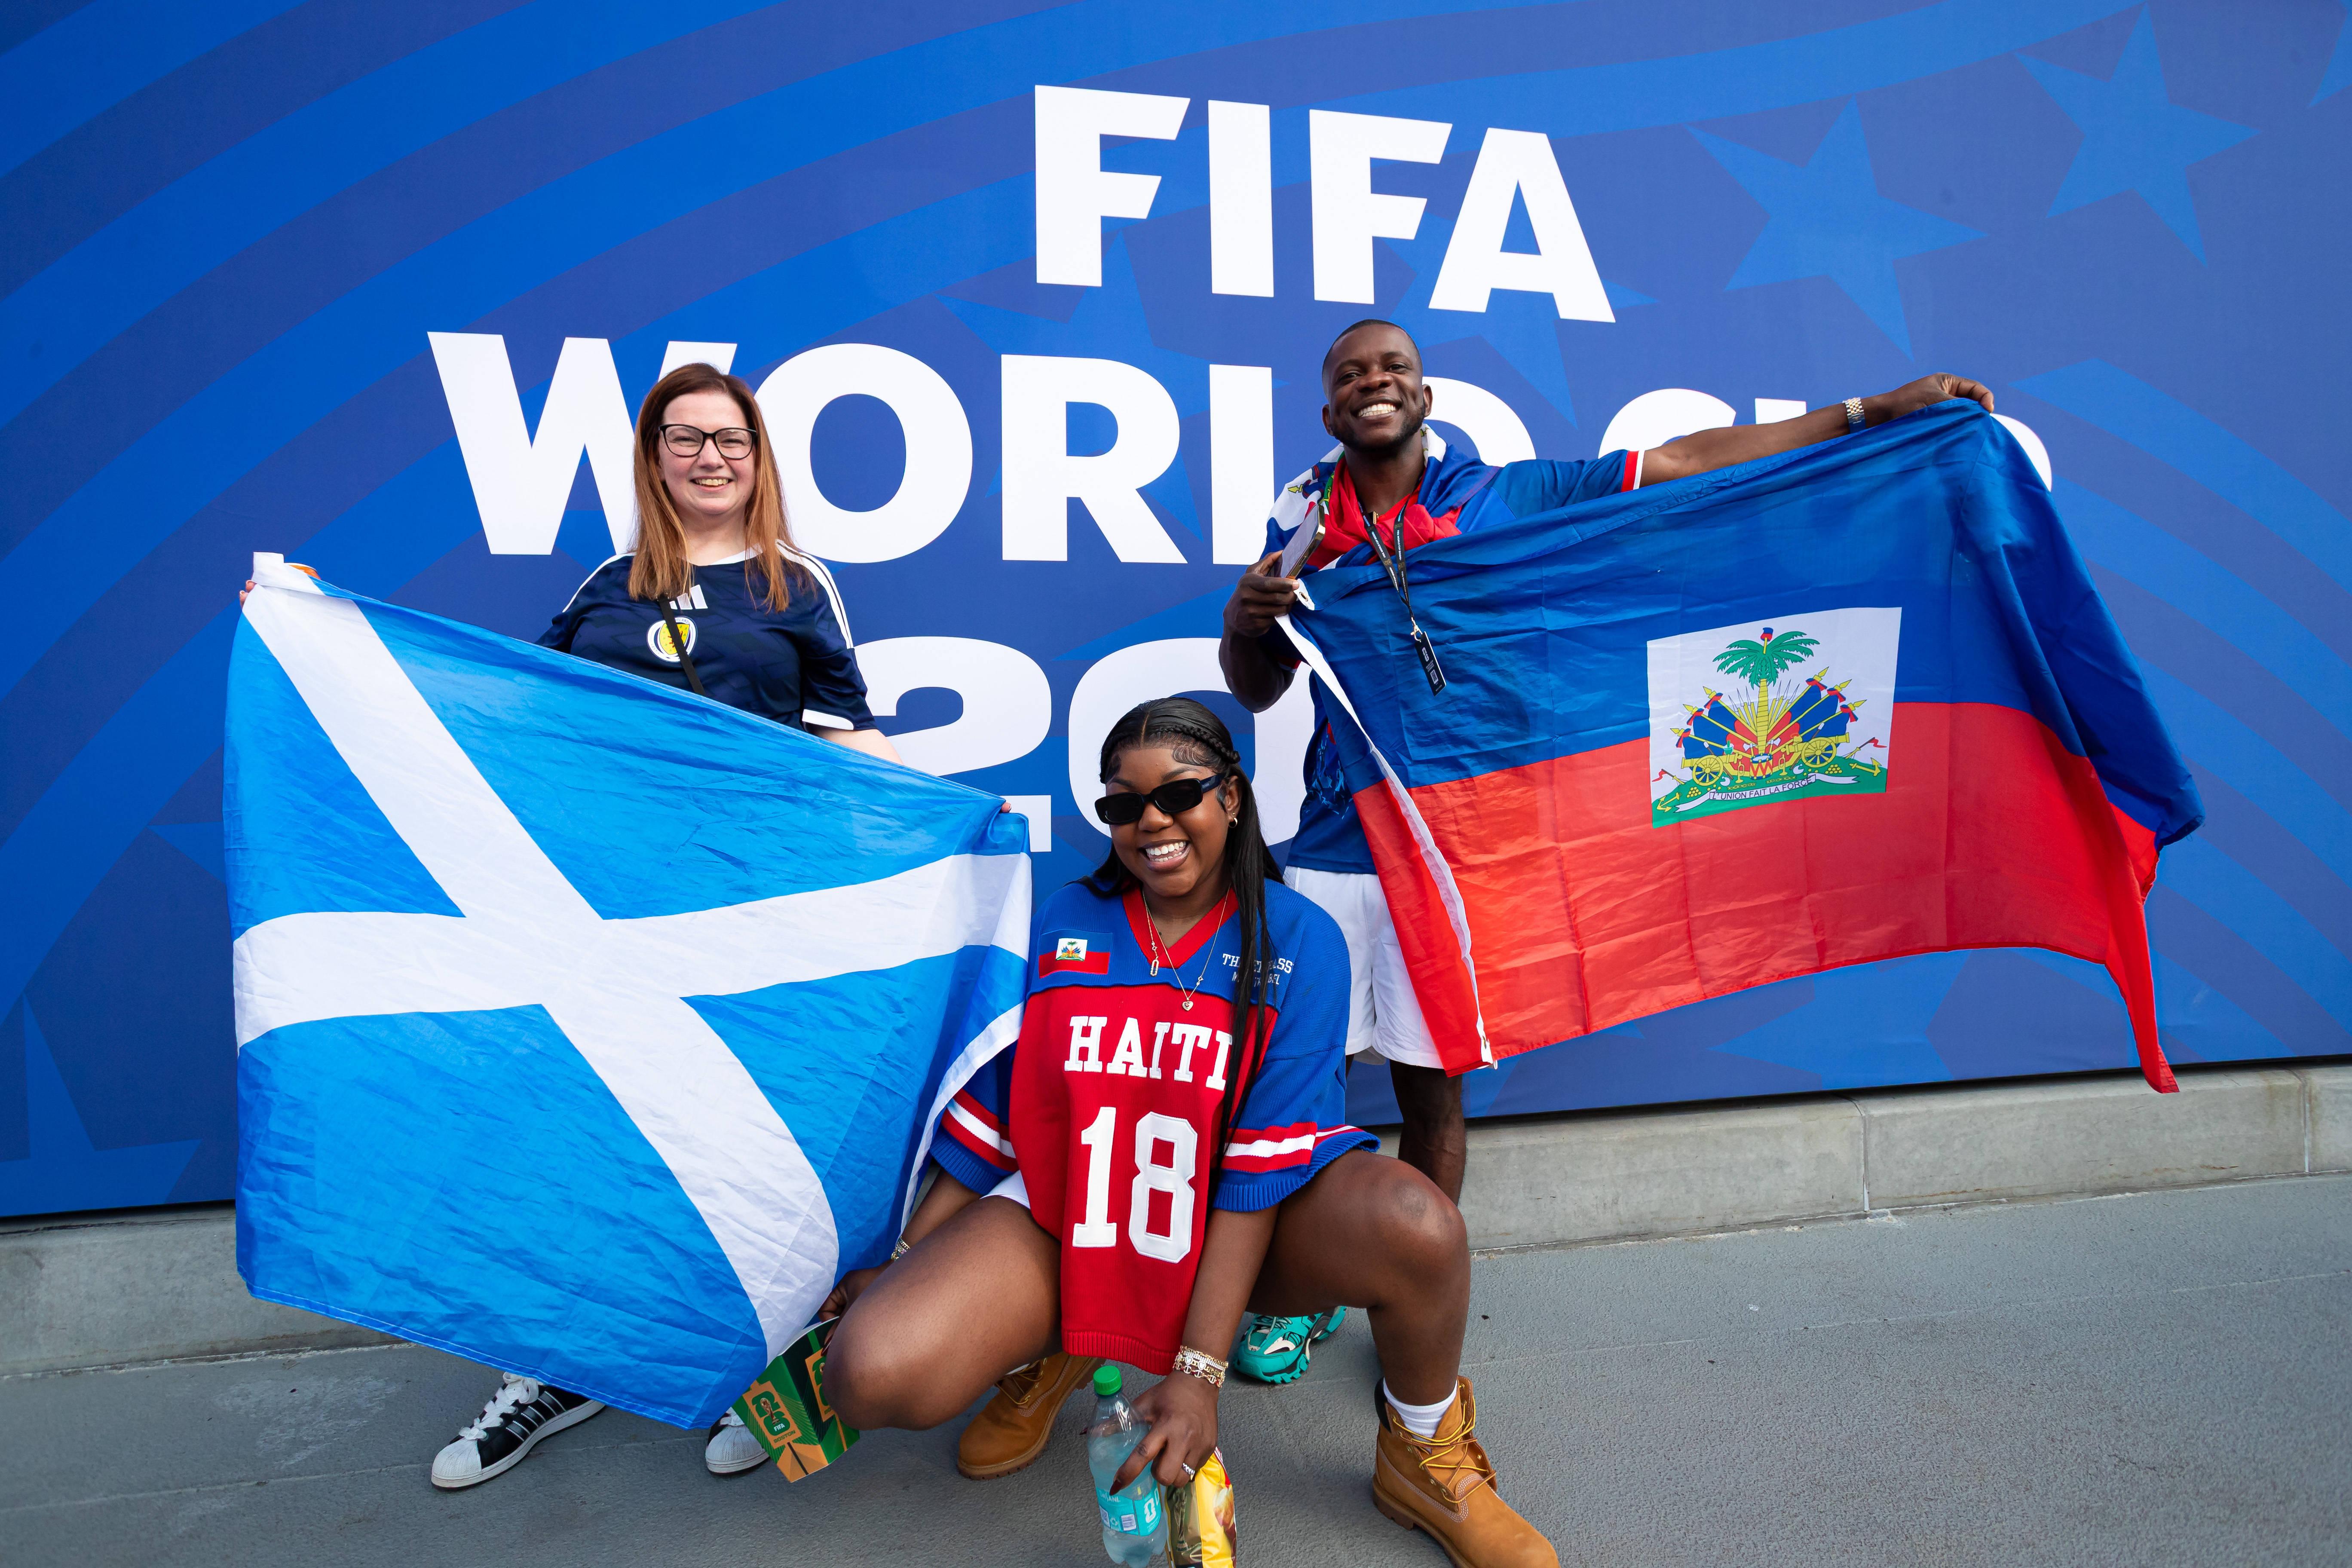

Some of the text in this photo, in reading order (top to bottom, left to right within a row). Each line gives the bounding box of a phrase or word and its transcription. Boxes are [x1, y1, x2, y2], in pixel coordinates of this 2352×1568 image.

[1035, 85, 1616, 323] FIFA
[1749, 788, 1767, 798] FAIT
[1782, 778, 1813, 790] FORCE
[1064, 1016, 1232, 1091] HAITI
[1072, 1107, 1198, 1264] 18
[773, 1423, 785, 1432] FIFA
[773, 1430, 796, 1443] BOSTON
